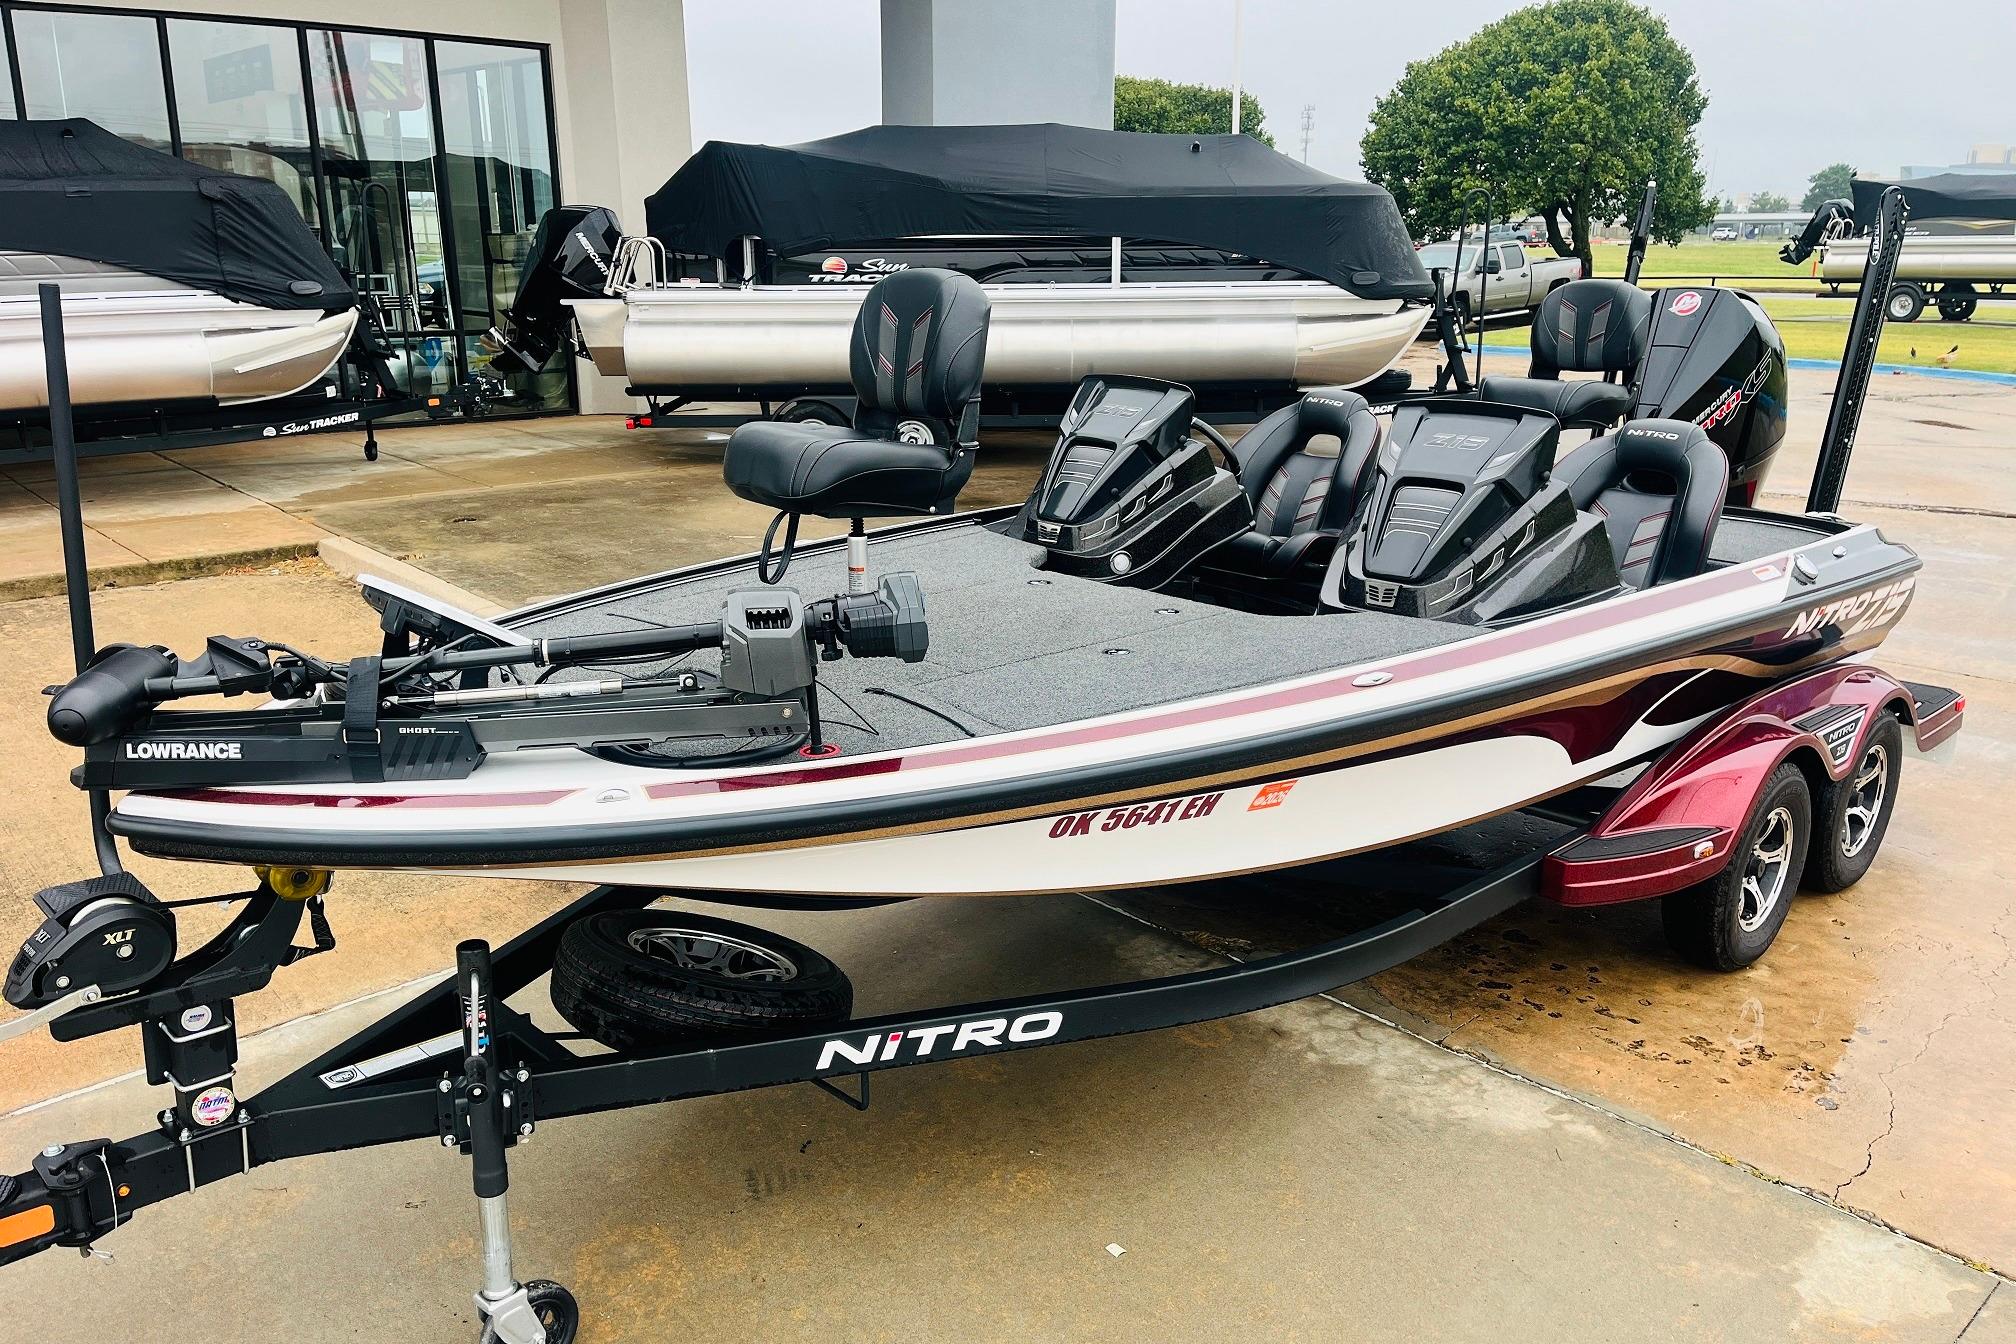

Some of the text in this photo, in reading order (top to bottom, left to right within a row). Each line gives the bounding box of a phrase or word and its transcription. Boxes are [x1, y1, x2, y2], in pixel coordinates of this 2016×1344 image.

[855, 258, 910, 272] Sun
[808, 274, 890, 283] TRAC
[1691, 384, 1734, 424] MERCURY
[280, 412, 359, 435] Sun TRACKER
[398, 727, 437, 735] GHOST
[1828, 722, 1856, 743] NITRO
[125, 742, 242, 760] LOWRANCE
[1048, 792, 1225, 839] OK 5641 EH
[34, 928, 52, 944] XLT
[102, 928, 137, 946] XLT
